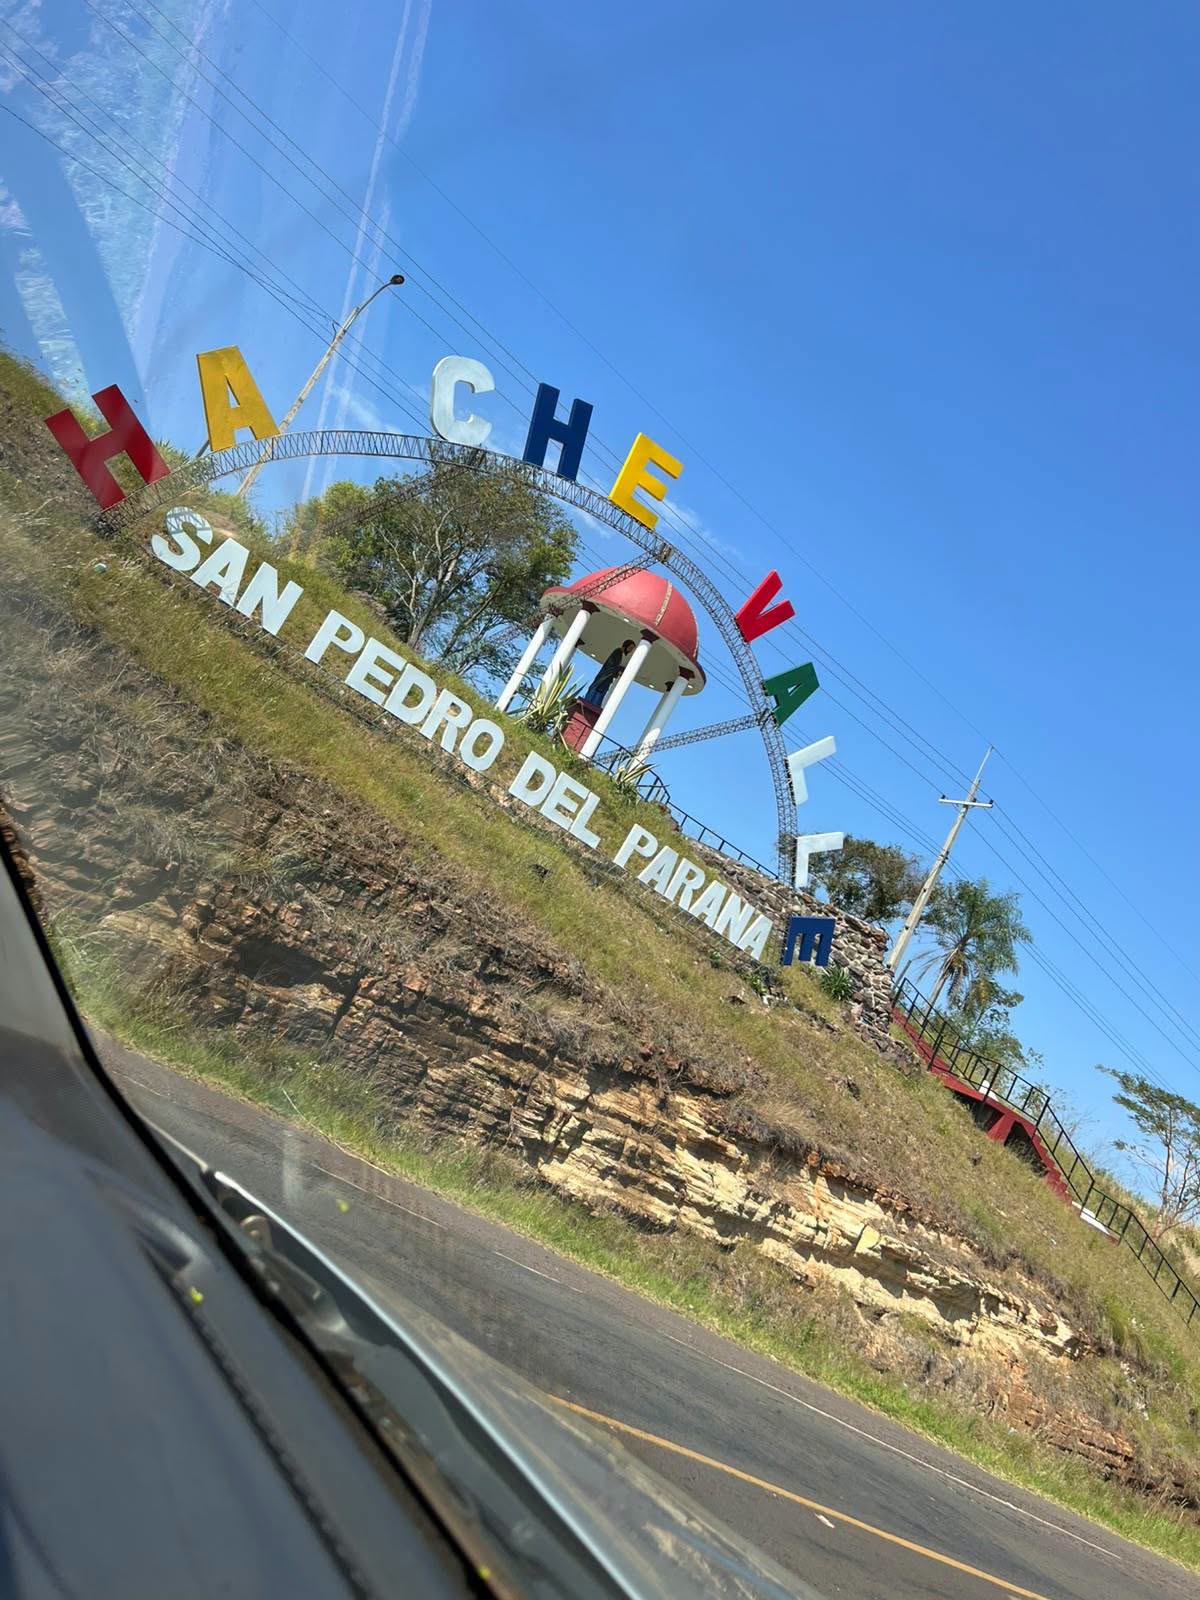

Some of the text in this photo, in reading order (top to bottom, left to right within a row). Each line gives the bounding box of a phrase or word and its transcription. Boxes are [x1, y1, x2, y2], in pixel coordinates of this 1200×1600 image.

[45, 345, 844, 967] HA CHE VALLE
[151, 506, 775, 961] SAN PEDRO DEL PARANA
